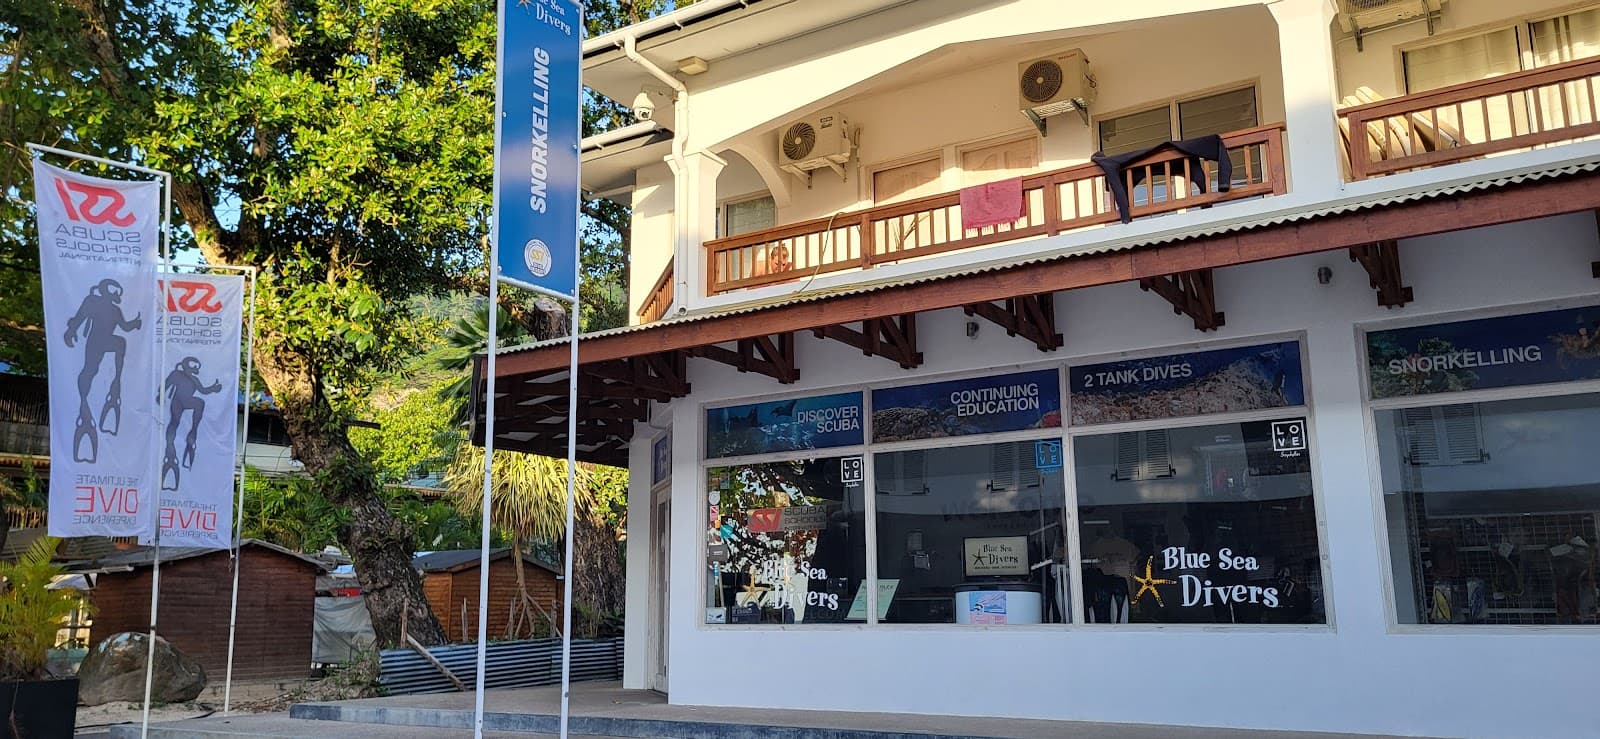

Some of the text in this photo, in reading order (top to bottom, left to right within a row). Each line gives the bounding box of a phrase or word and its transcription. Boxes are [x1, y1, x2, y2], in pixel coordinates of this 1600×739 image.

[536, 3, 571, 36] Divers
[530, 47, 549, 214] SNORKELLING
[1388, 345, 1542, 376] SNORKELLING
[1084, 364, 1192, 387] 2 TANK DIVES
[950, 383, 1038, 405] CONTINUING
[797, 406, 859, 424] DISCOVER
[957, 397, 1039, 417] EDUCATION
[816, 420, 860, 433] SCUBA
[784, 506, 825, 516] SCUBA
[801, 560, 828, 580] Sea
[1162, 546, 1259, 571] Blue Sea
[773, 582, 839, 611] Divers
[1179, 574, 1279, 608] Divers
